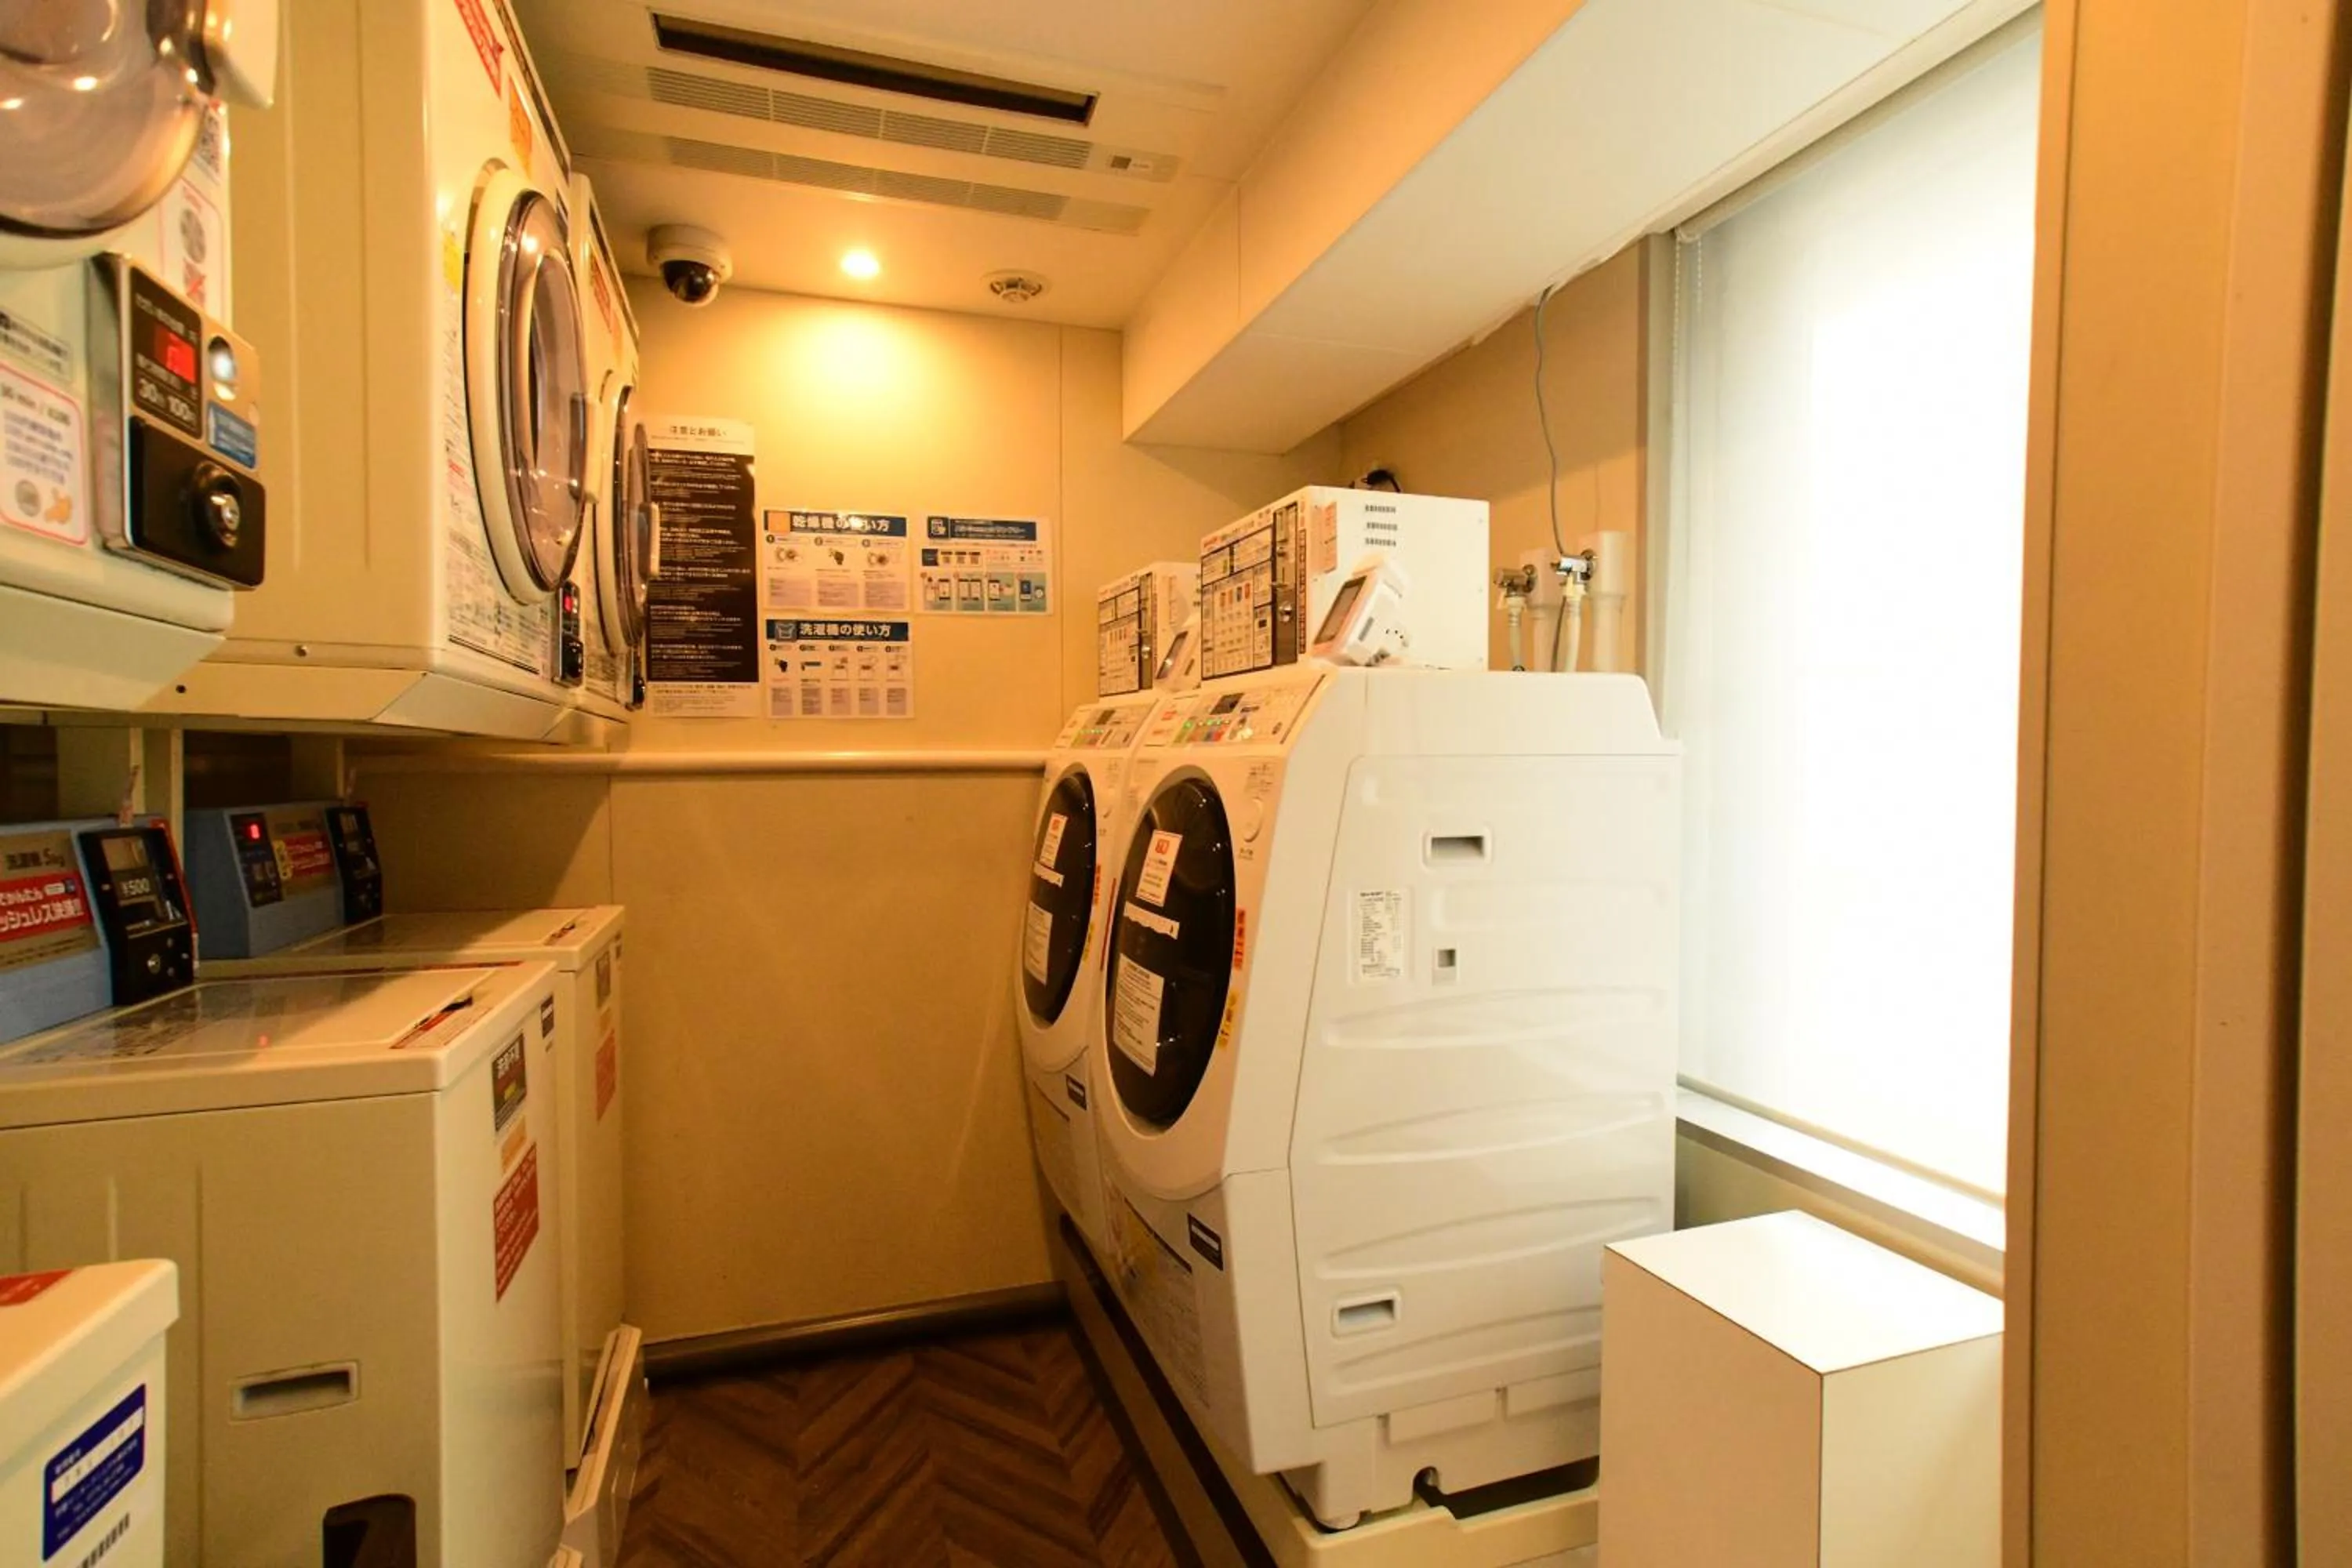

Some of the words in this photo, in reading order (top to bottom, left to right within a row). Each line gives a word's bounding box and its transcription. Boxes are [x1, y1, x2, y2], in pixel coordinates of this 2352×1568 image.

[800, 622, 891, 638] 洗濯機の使い方
